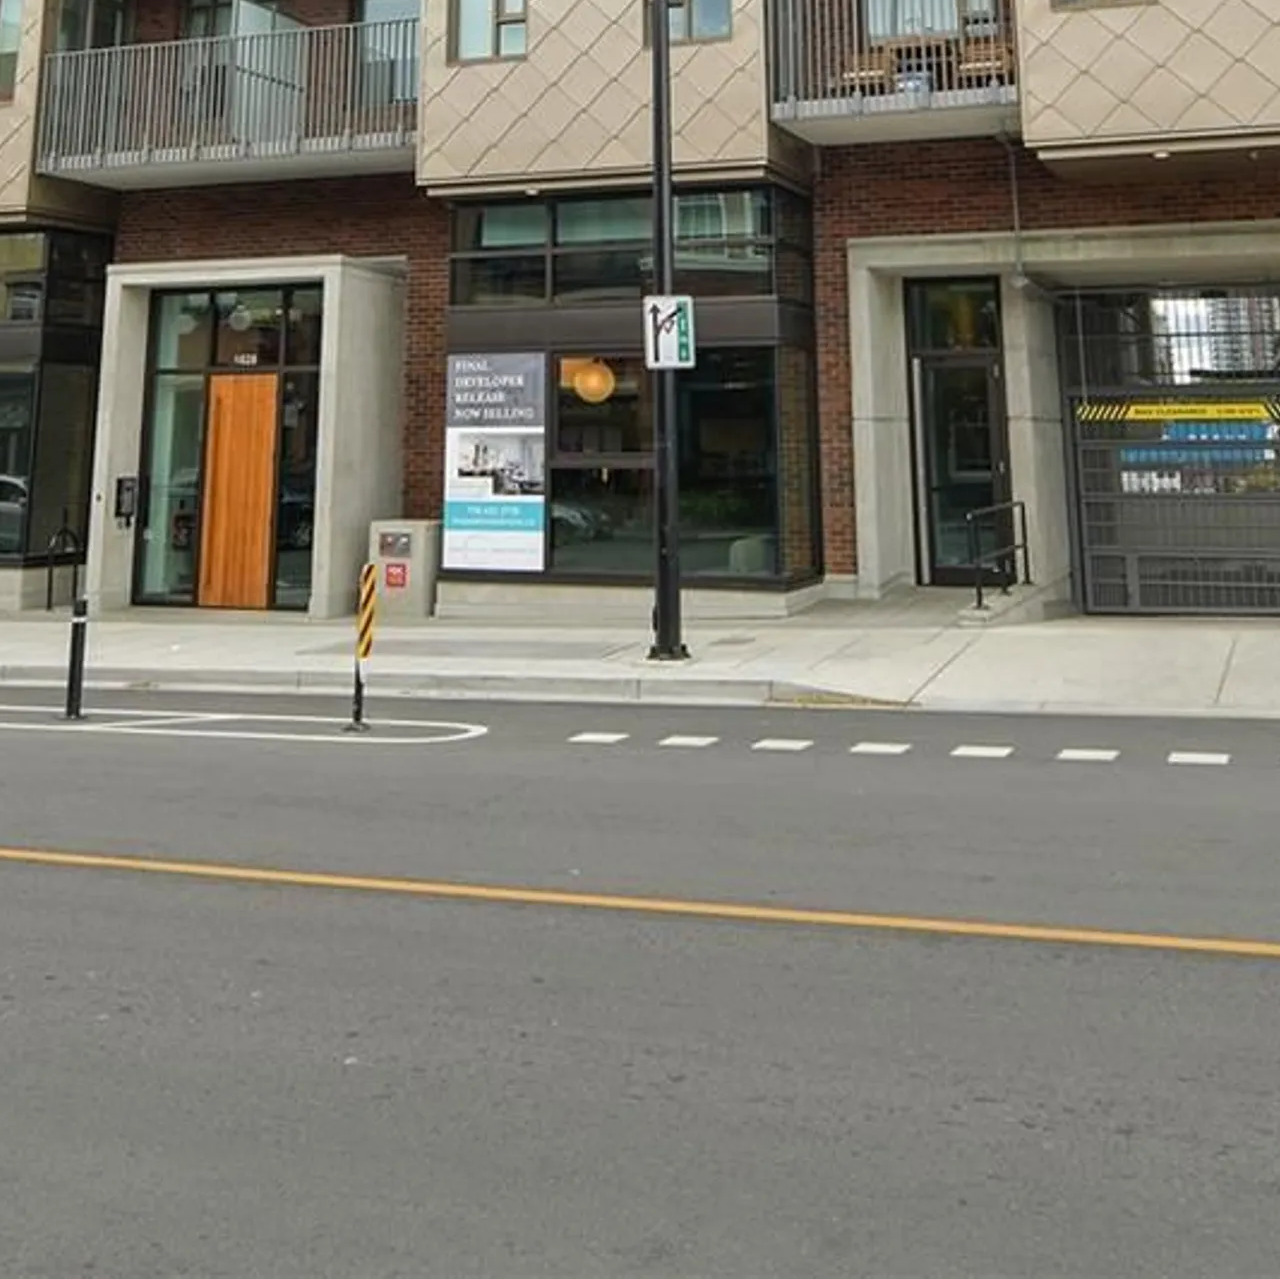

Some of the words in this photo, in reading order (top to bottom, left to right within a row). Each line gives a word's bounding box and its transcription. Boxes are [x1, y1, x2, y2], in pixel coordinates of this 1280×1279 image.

[455, 360, 491, 373] FINAL
[455, 375, 524, 388] DEVELOPER
[455, 392, 505, 404] RELEASE
[454, 408, 481, 420] NOW
[483, 407, 534, 420] SELLING
